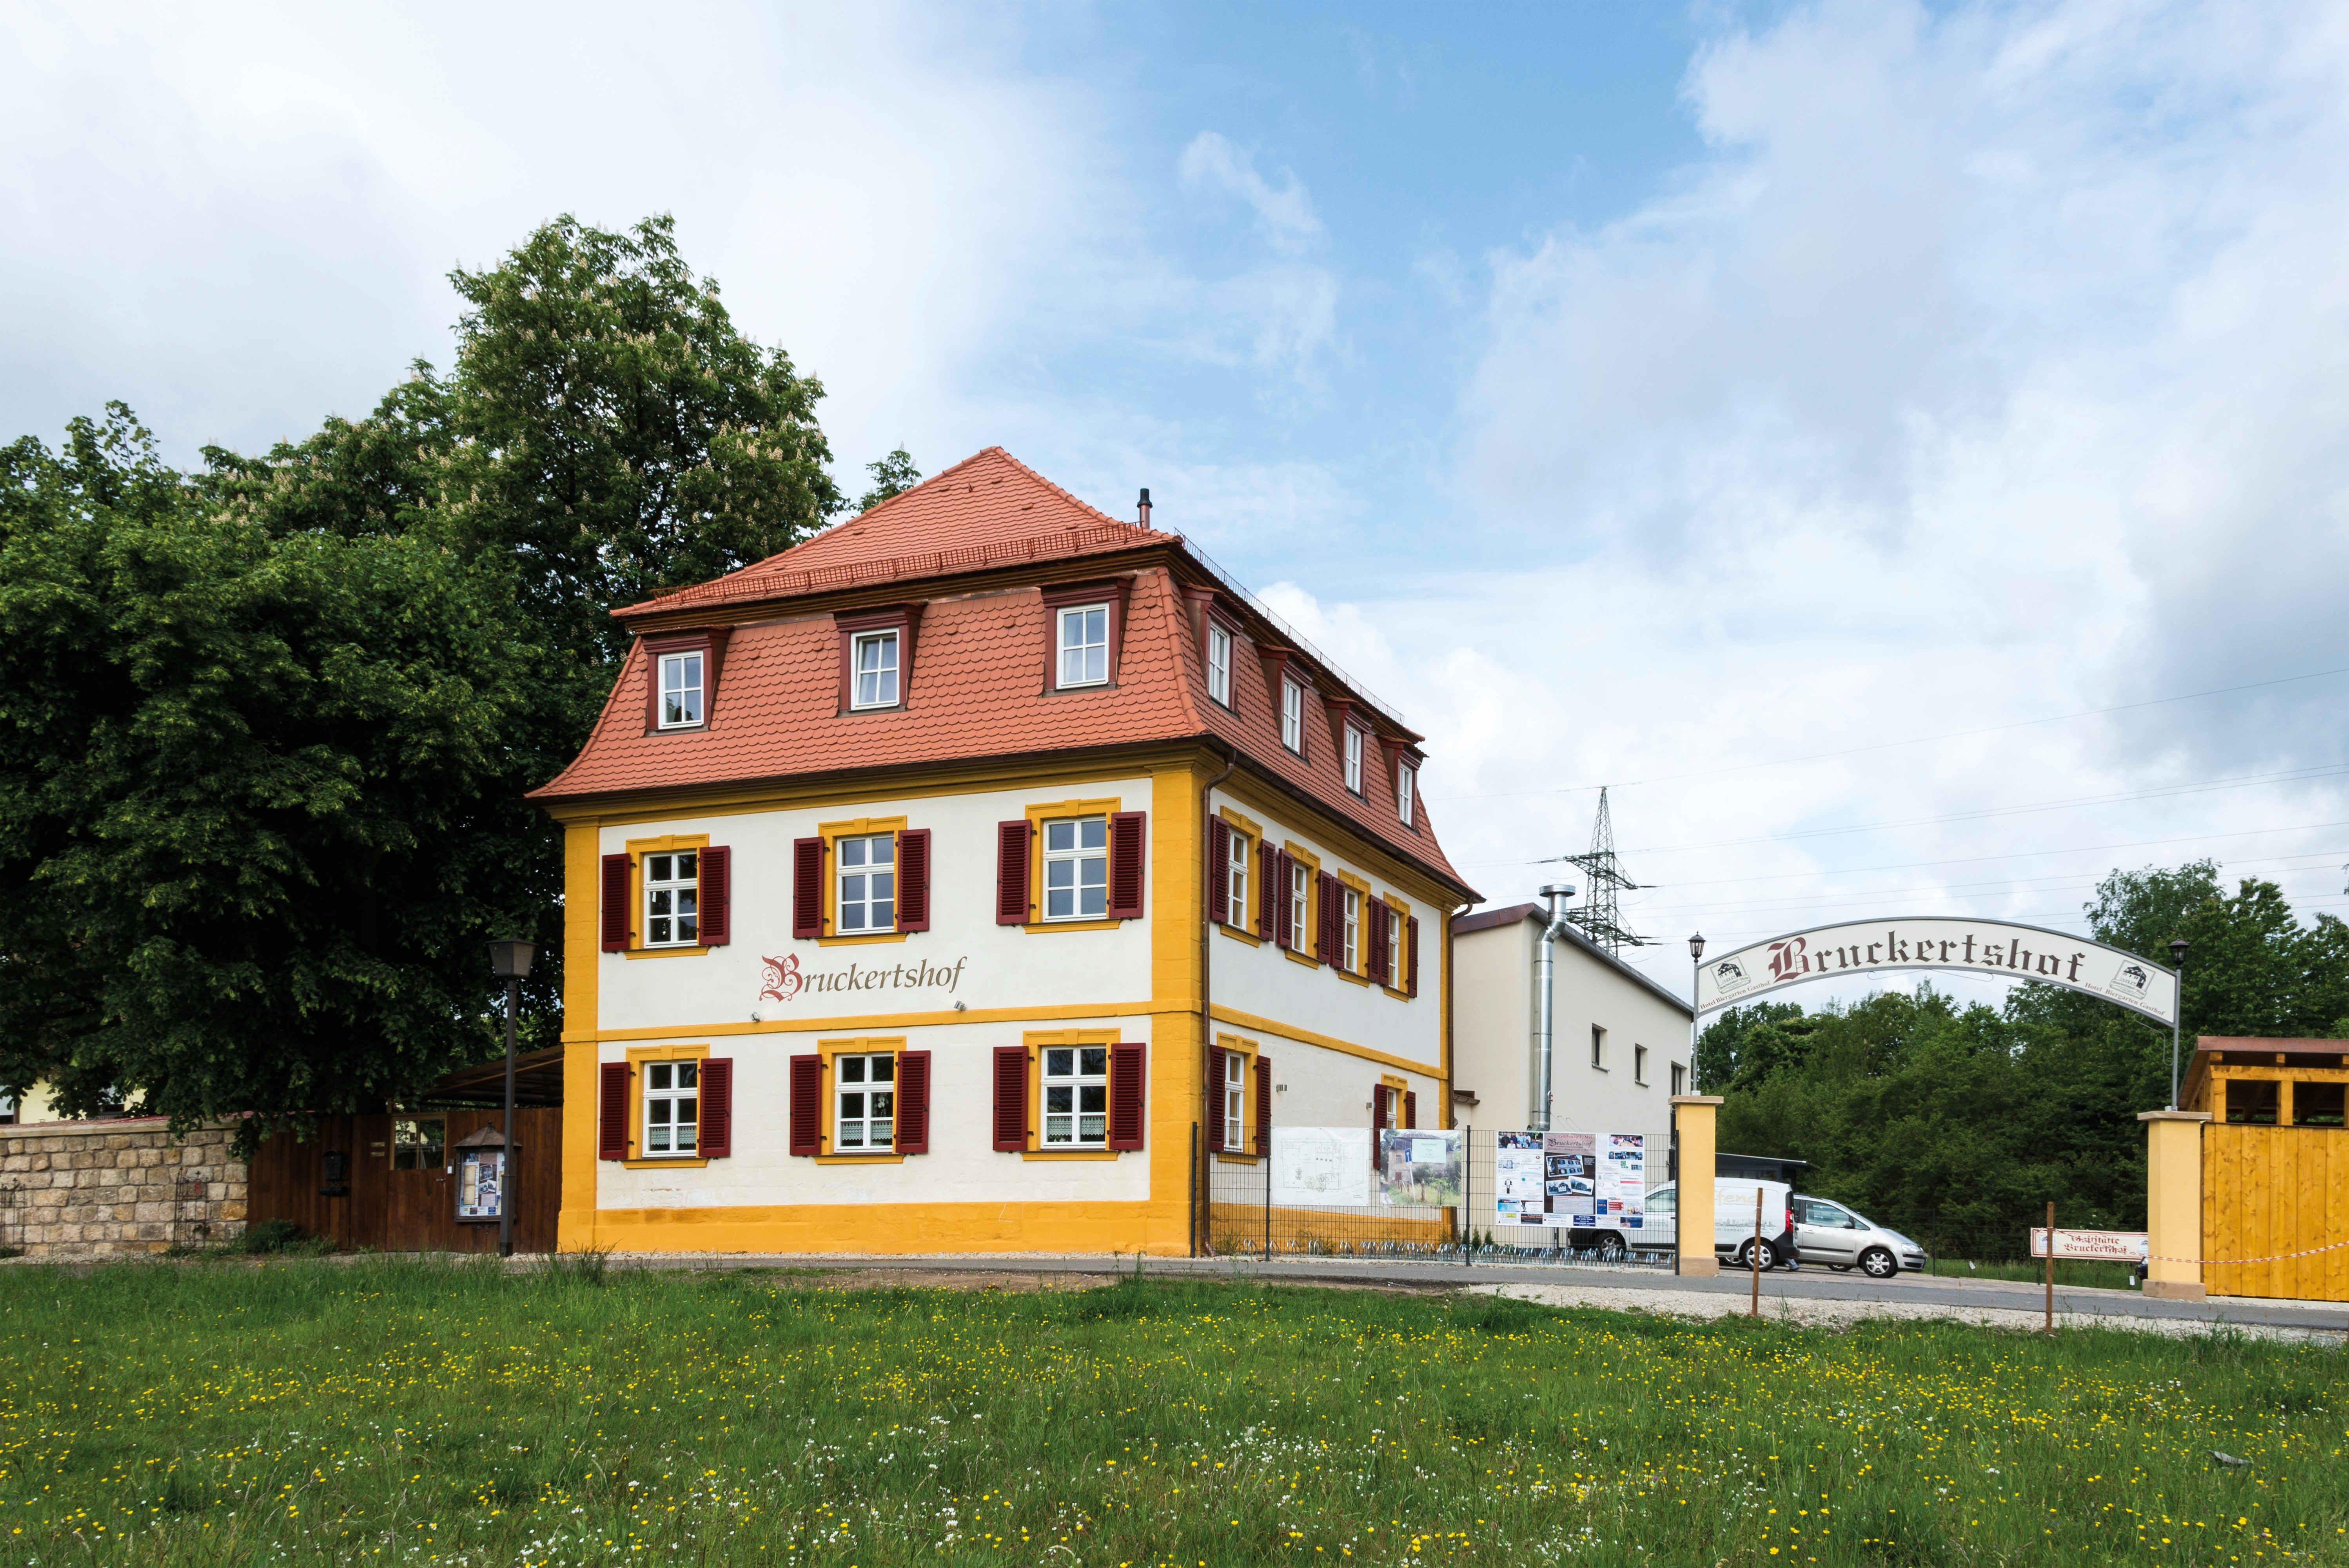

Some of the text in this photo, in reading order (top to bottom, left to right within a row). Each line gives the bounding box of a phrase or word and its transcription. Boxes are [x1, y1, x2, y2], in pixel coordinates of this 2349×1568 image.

[1766, 930, 2086, 983] Bruckertshof
[759, 953, 967, 1003] Bruckertshof
[1700, 1000, 1715, 1009] Hotel
[1716, 989, 1746, 1003] Biergarten
[1747, 981, 1770, 991] Gasthof
[2085, 982, 2102, 991] Hotel
[2105, 989, 2138, 1005] Biergarten
[2140, 1002, 2166, 1016] Gasthof
[1547, 1138, 1593, 1147] Bruckertshof
